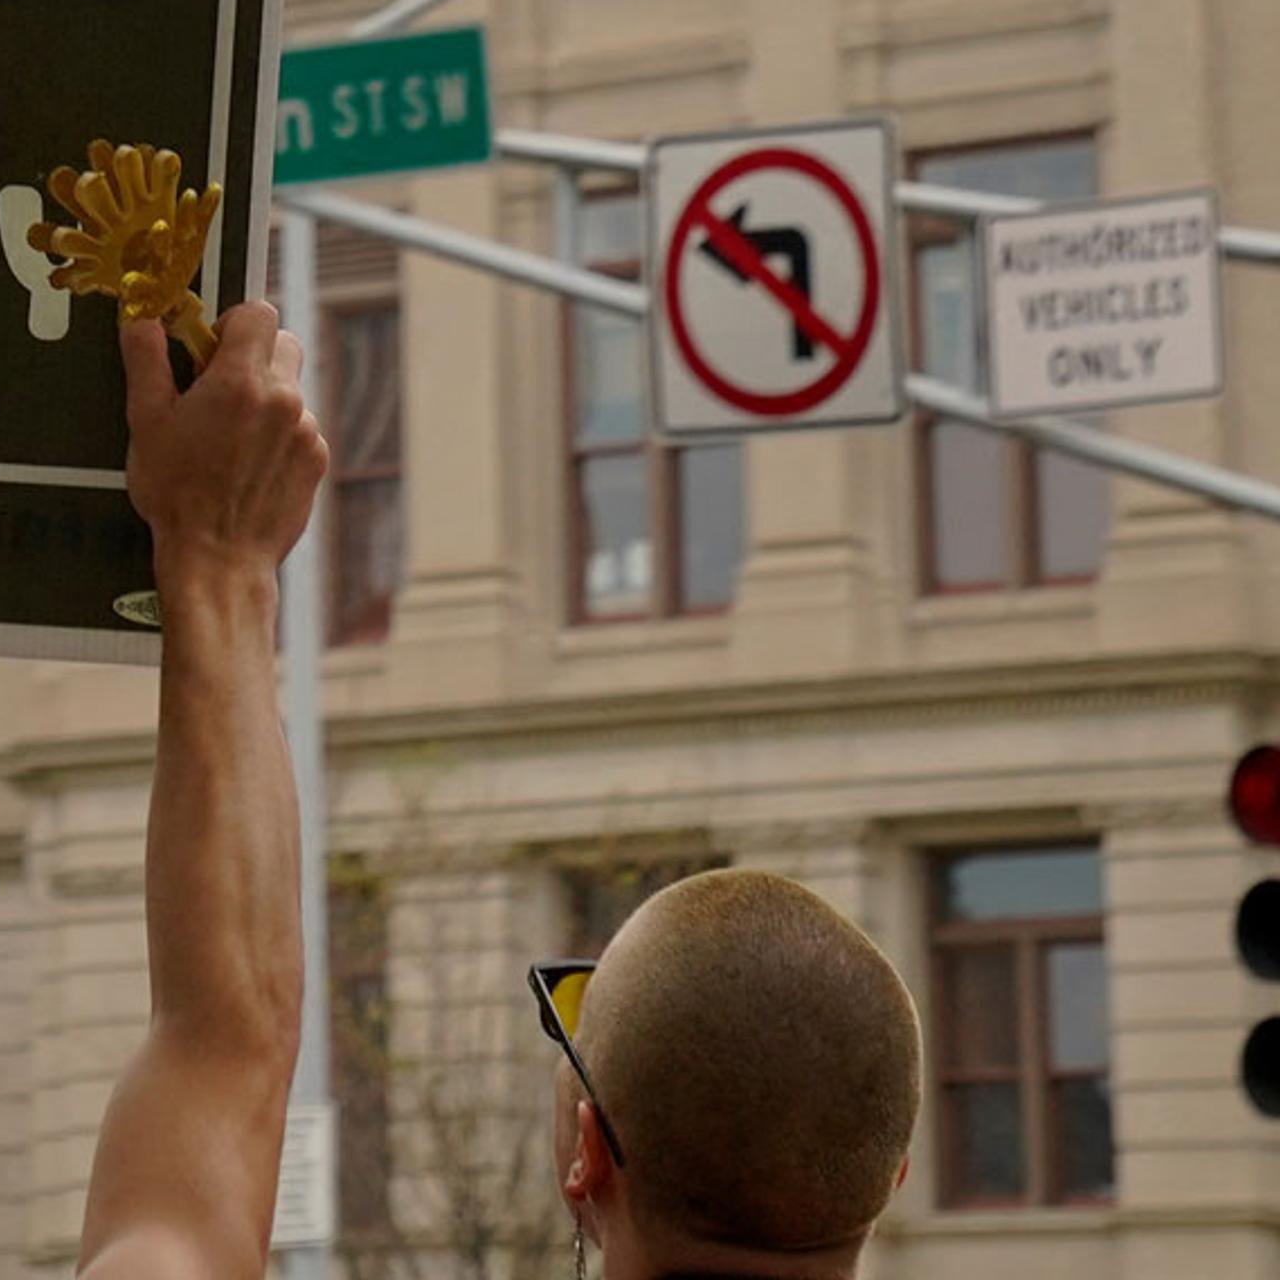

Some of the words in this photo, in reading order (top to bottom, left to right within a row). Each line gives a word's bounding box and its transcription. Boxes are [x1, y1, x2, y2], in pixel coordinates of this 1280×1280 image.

[331, 79, 386, 138] ST
[401, 71, 468, 130] SW
[996, 215, 1210, 275] AUTHORIZED
[1020, 274, 1188, 333] VEHICLES
[1046, 338, 1162, 390] ONLY
